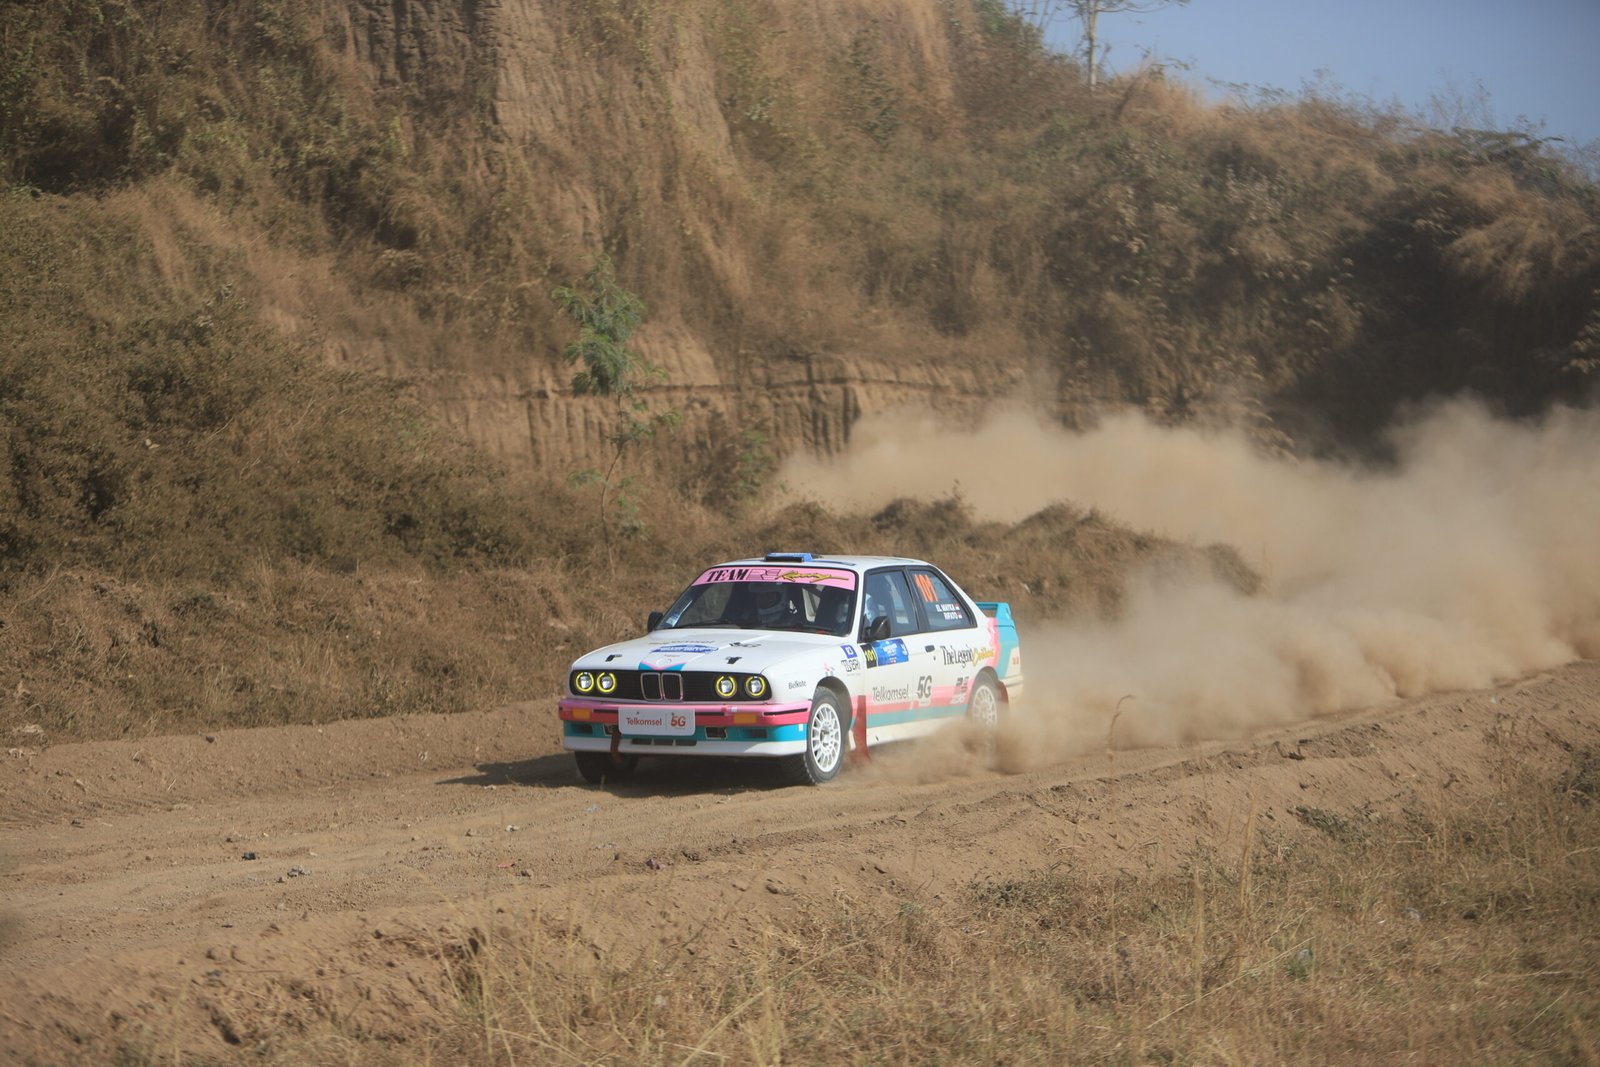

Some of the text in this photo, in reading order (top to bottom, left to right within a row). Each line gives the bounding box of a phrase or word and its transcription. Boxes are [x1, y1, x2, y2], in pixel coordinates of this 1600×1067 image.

[706, 568, 750, 582] TEAM
[914, 575, 939, 602] 101
[864, 650, 877, 662] 101
[941, 645, 954, 666] The
[954, 644, 974, 669] Legend
[872, 675, 933, 702] Telkomsel 5G
[626, 715, 687, 727] Telkomsel 5G
